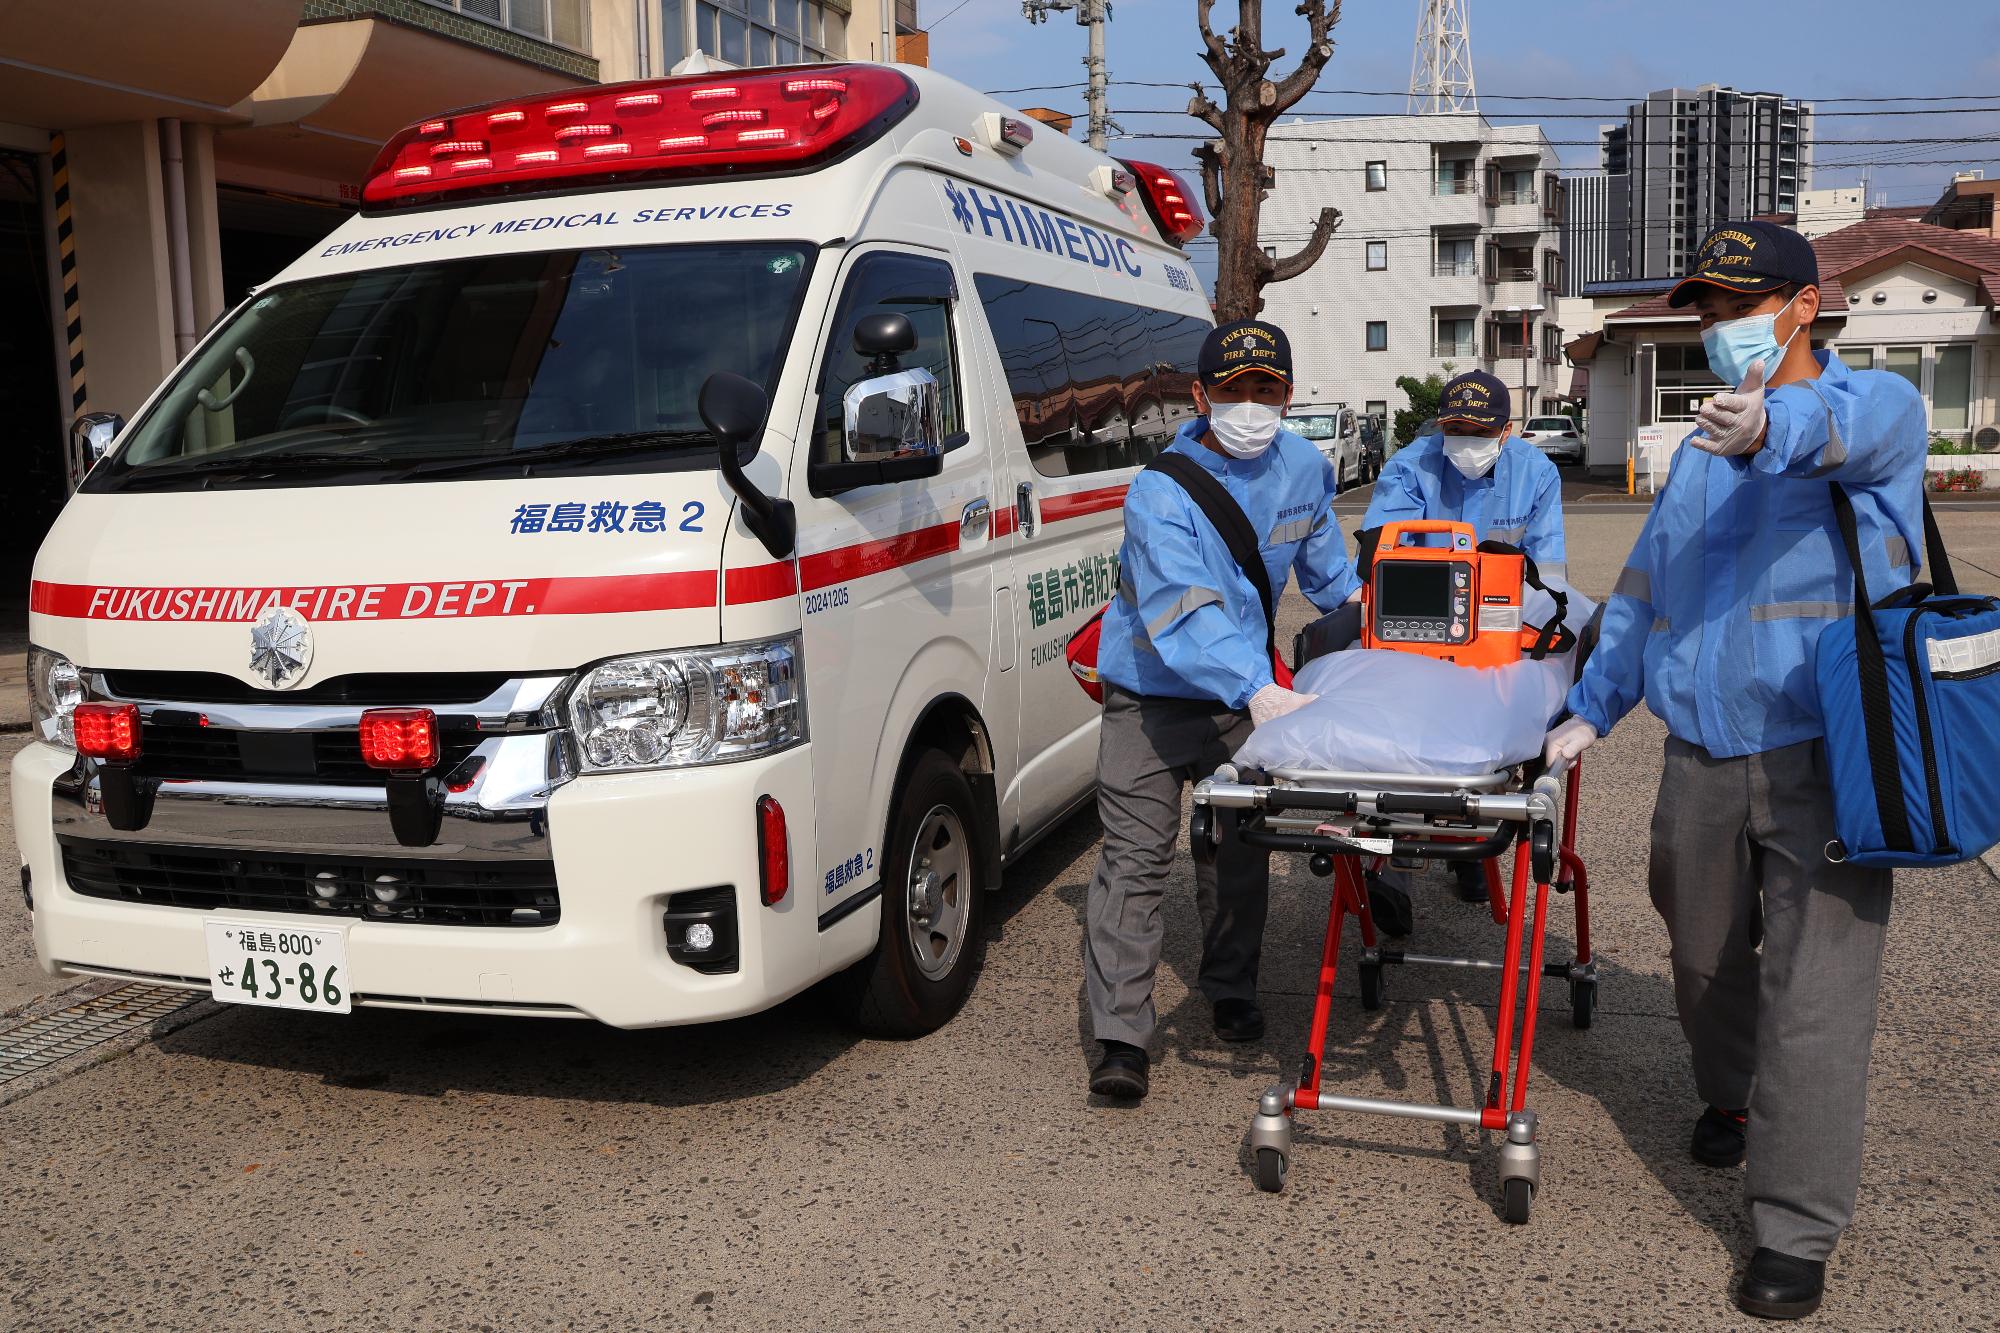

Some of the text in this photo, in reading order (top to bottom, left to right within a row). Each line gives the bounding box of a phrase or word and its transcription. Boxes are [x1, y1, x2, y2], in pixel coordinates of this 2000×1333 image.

[320, 203, 793, 258] EMERGENCY MEDICAL SERVICES
[967, 187, 1142, 278] HIMEDIC
[1220, 327, 1277, 348] FUKUSHIMA
[1223, 349, 1277, 362] FIRE DEPT.
[1448, 382, 1491, 398] FUKUSHIMA
[290, 586, 387, 619] FIRE
[400, 581, 536, 617] DEPT.
[805, 587, 849, 615] 20241205
[217, 957, 342, 1006] せ 43-86
